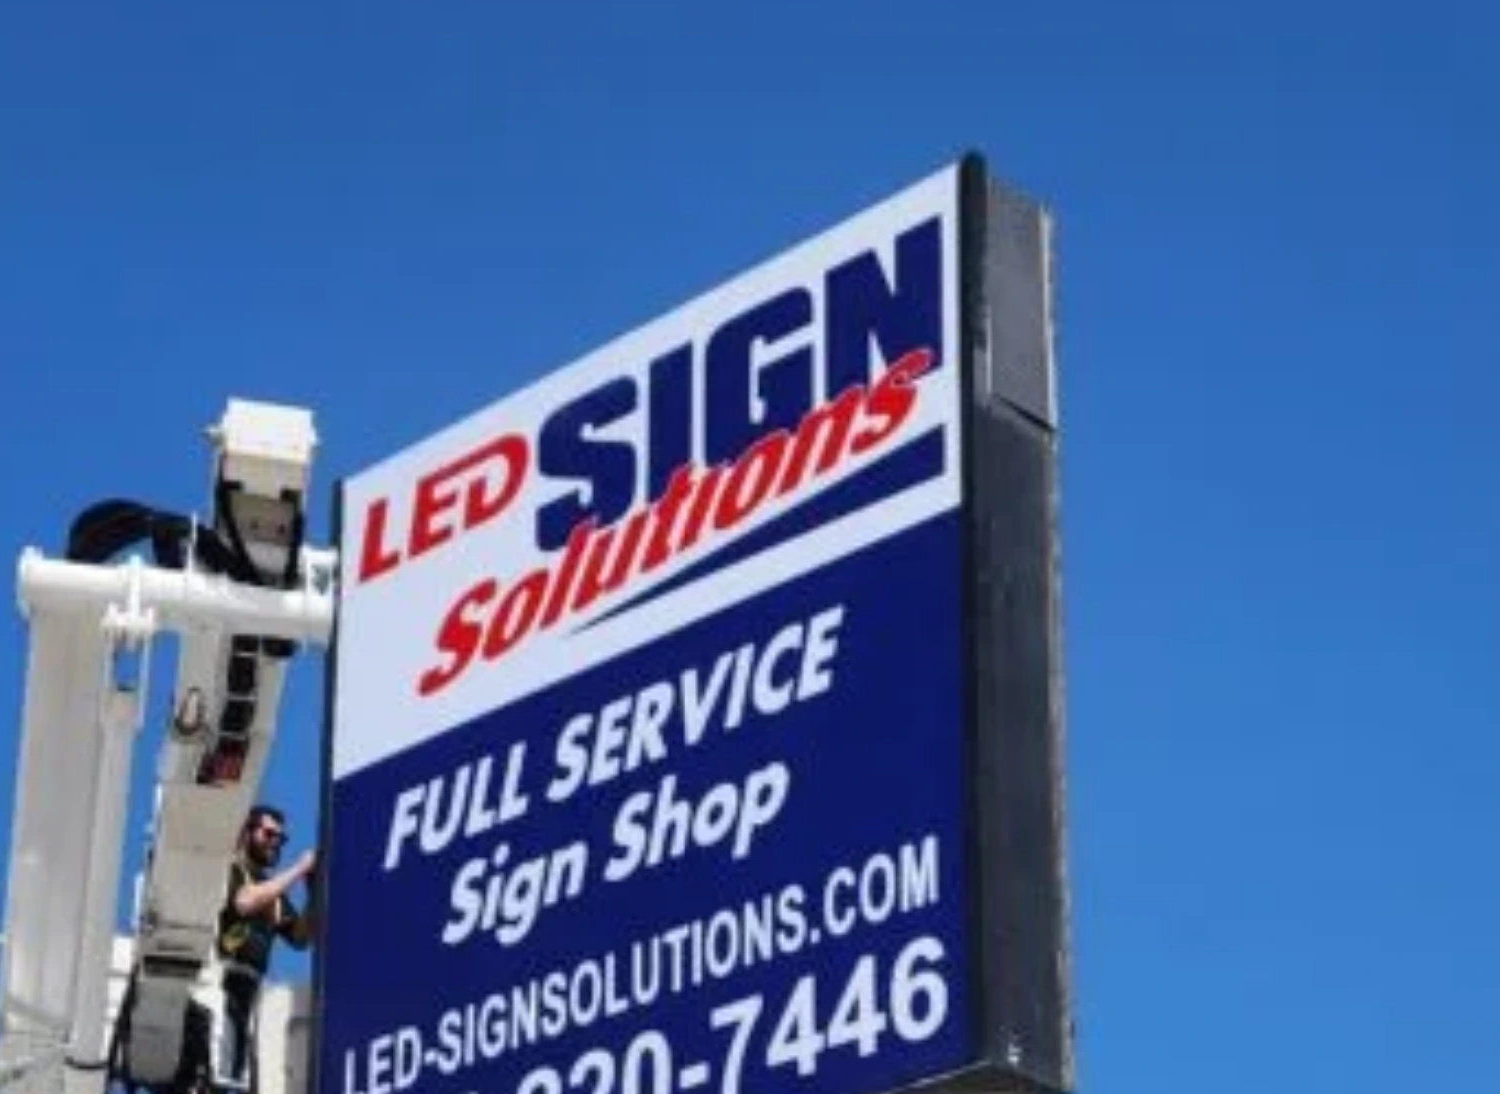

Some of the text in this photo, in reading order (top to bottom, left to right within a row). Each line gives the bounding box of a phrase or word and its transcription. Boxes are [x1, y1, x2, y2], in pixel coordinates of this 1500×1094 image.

[359, 212, 943, 584] LED SIGN
[416, 347, 936, 698] Solutions
[383, 605, 845, 870] FULL SERVICE
[442, 761, 790, 947] Sign Shop
